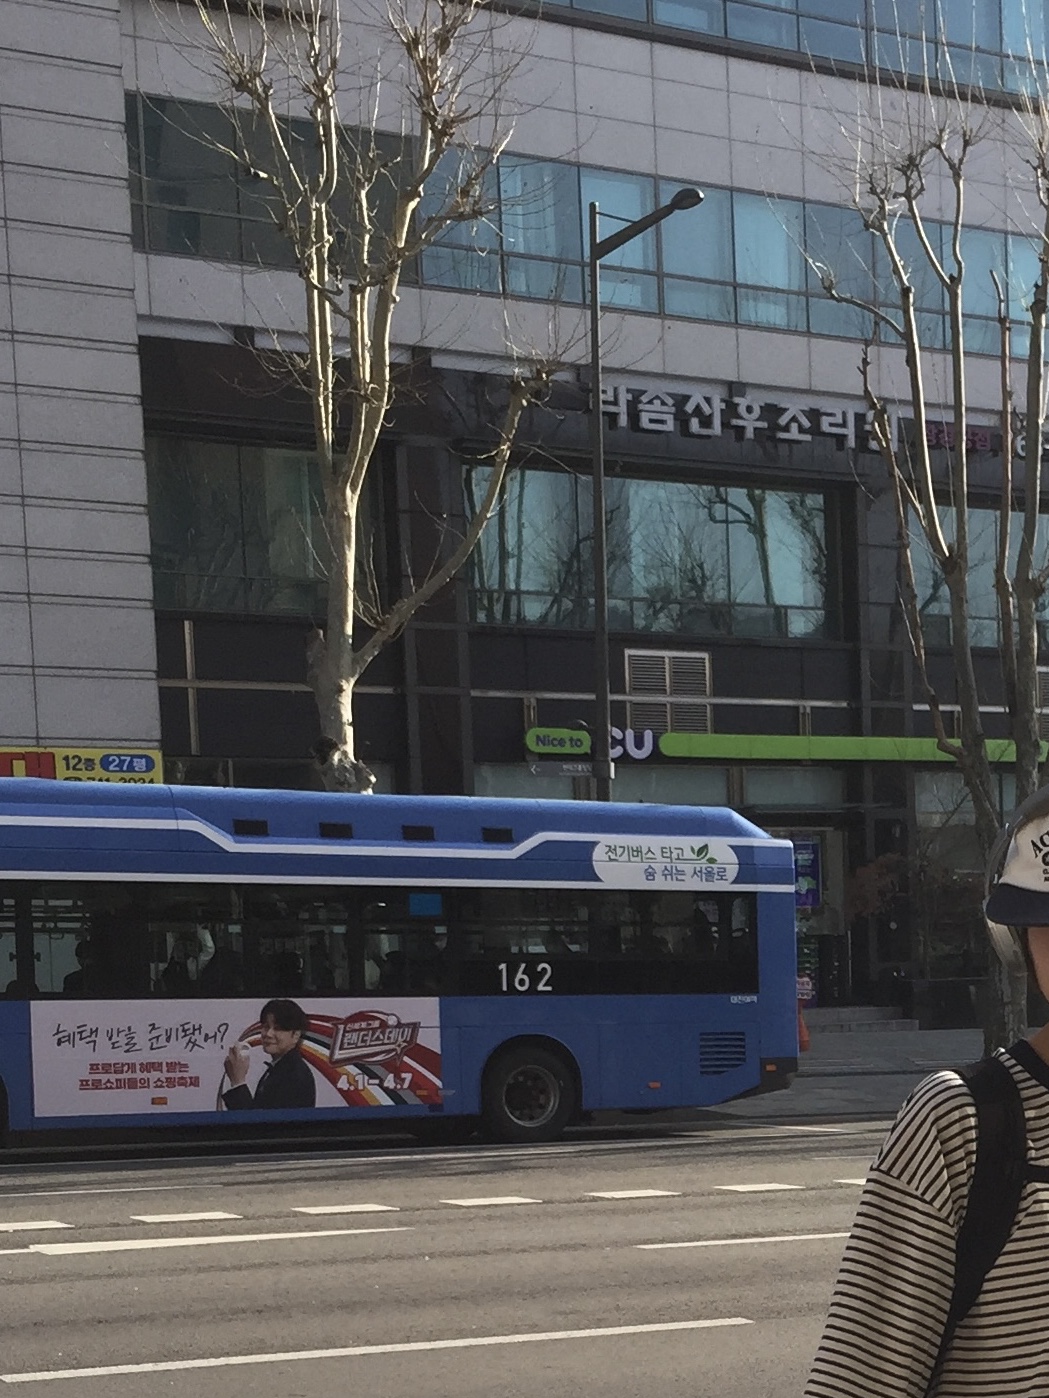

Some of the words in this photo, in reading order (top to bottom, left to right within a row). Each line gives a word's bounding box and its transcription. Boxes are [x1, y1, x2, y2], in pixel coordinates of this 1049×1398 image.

[536, 735, 565, 748] Nice
[569, 736, 583, 748] to
[108, 755, 146, 772] 27평
[604, 845, 657, 862] 전기버스
[661, 847, 684, 863] 타고
[661, 866, 687, 882] 쉬는
[691, 867, 729, 883] 서울로
[498, 962, 553, 992] 162
[52, 1023, 99, 1052] 혜택
[106, 1026, 143, 1053] 받을
[148, 1021, 229, 1052] 준비됐어?
